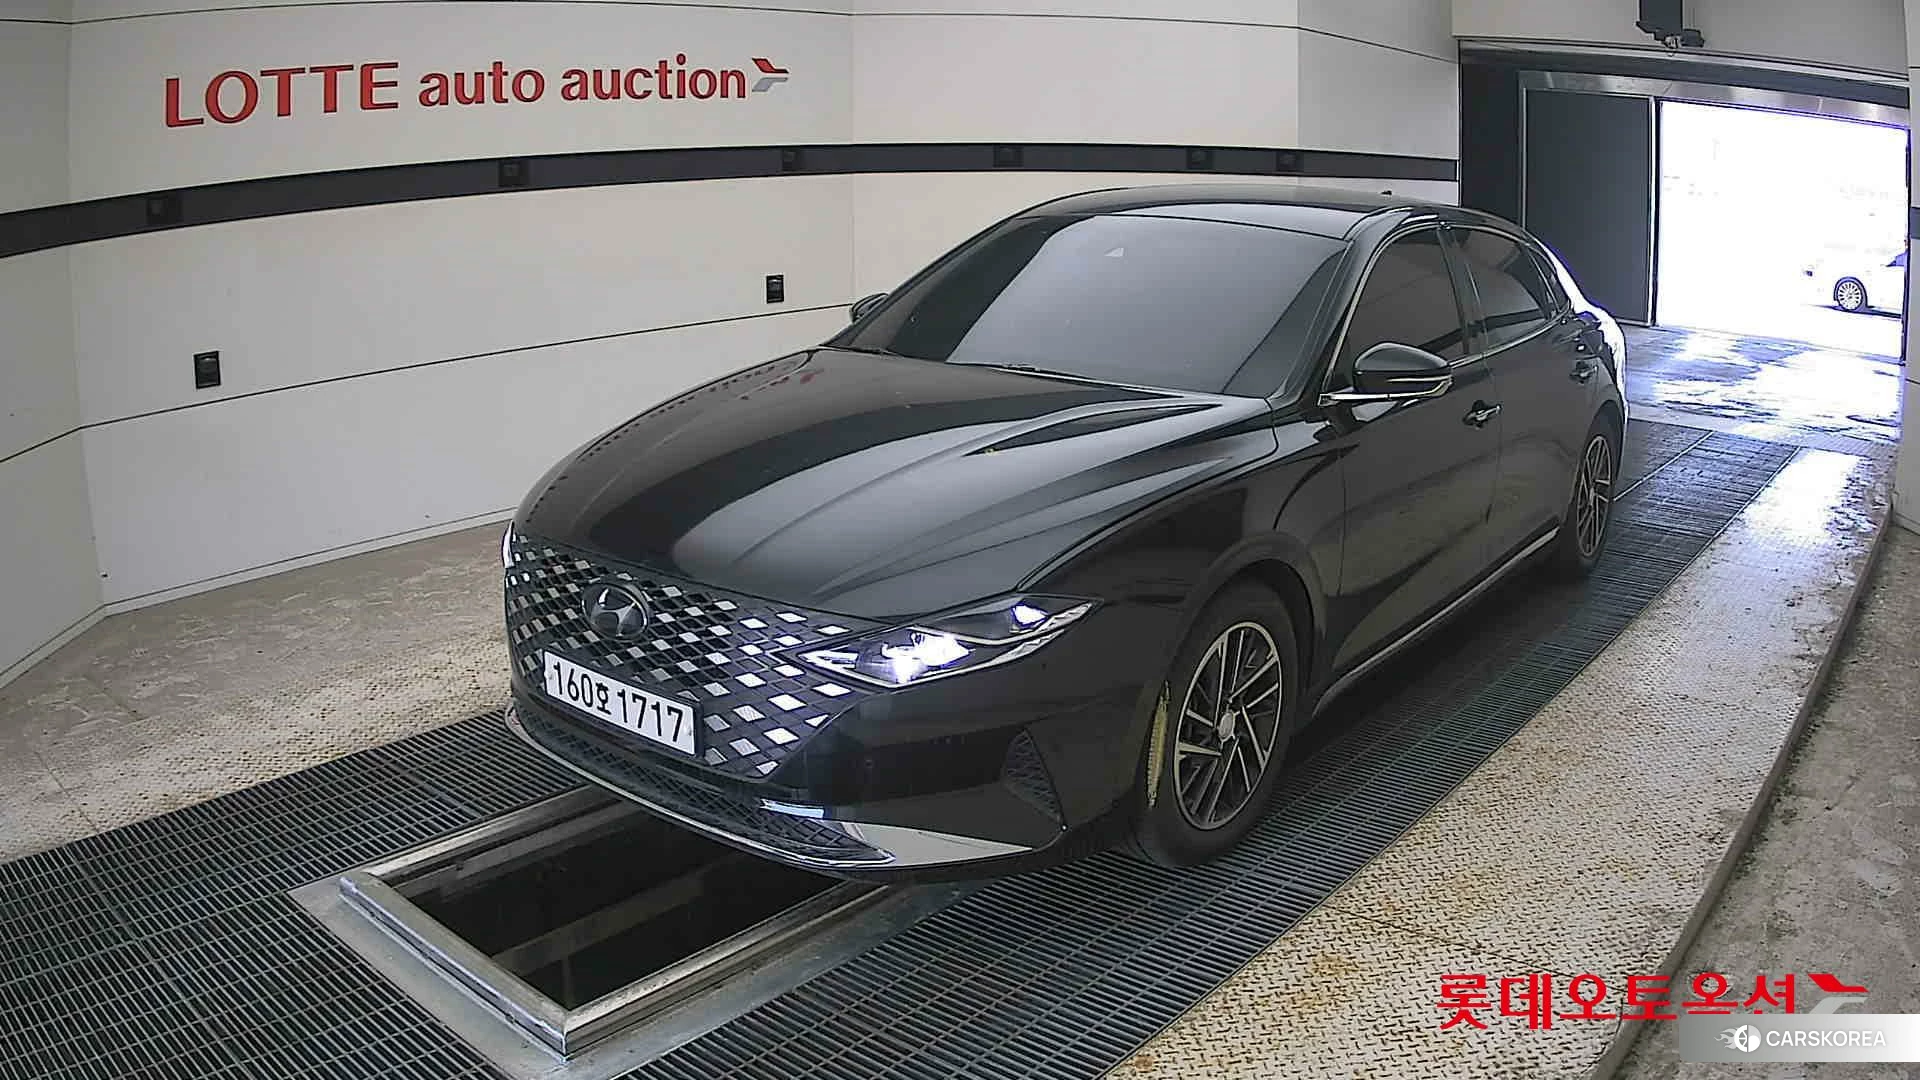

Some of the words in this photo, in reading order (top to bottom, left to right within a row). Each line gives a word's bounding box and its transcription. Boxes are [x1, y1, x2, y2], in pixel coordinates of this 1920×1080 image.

[164, 61, 400, 128] LOTTE
[418, 61, 546, 107] auto
[560, 53, 748, 101] auction
